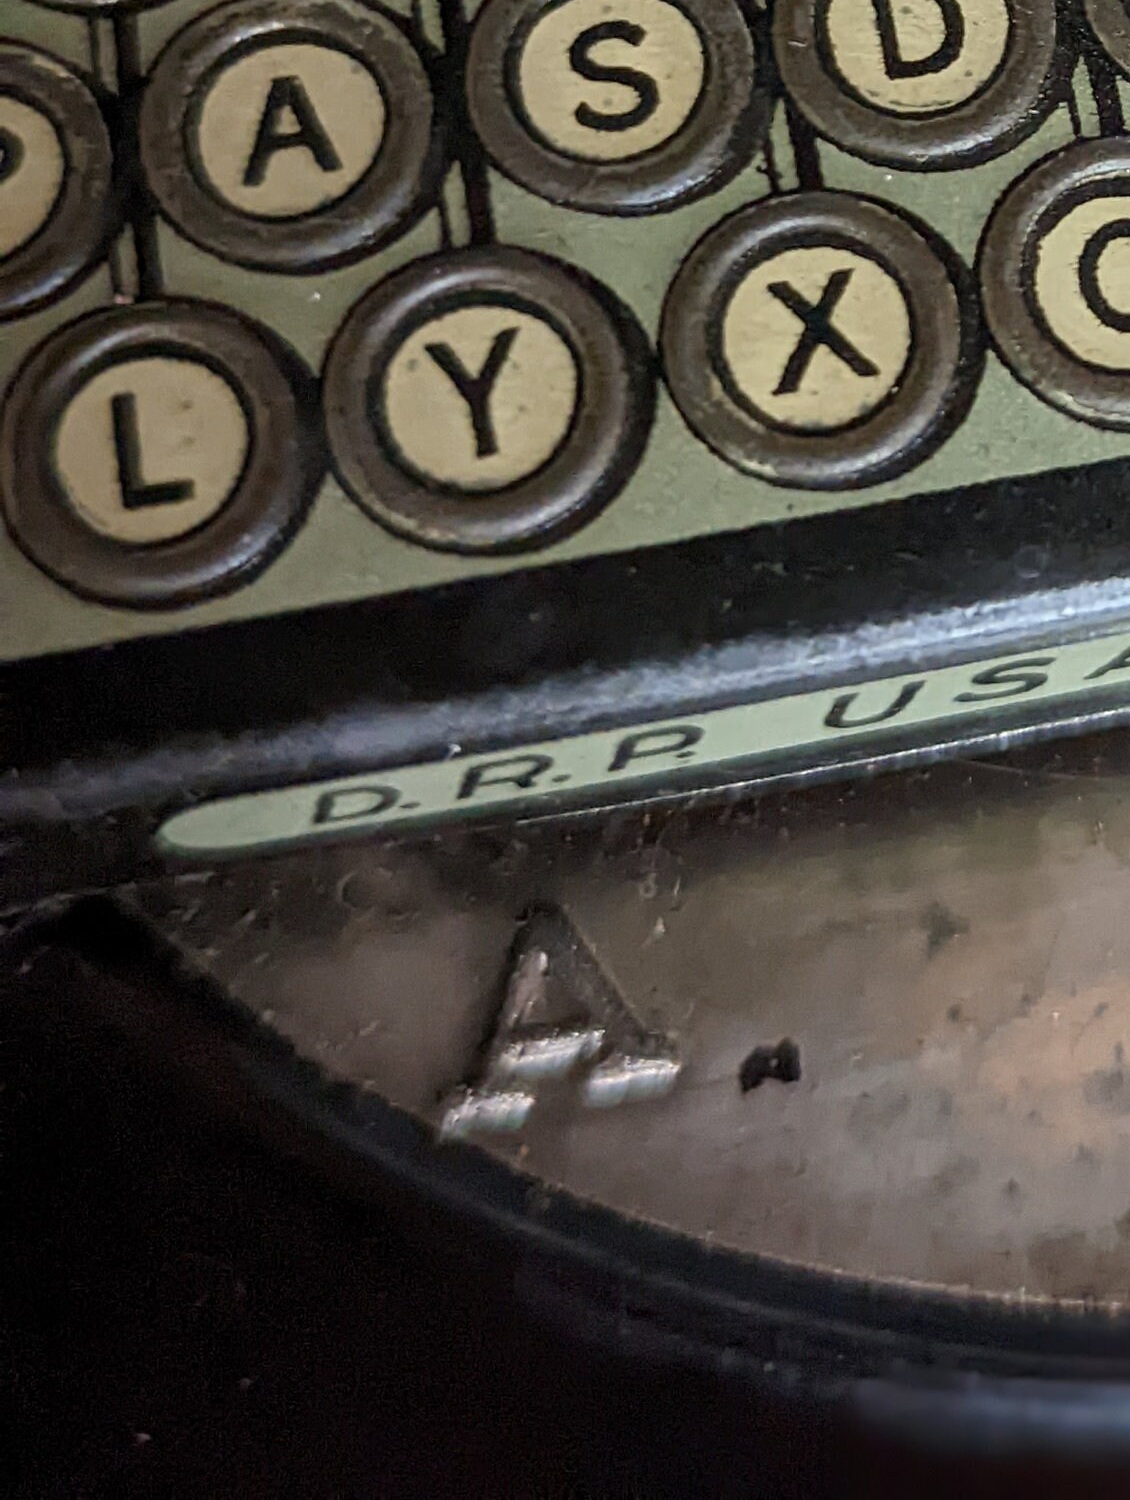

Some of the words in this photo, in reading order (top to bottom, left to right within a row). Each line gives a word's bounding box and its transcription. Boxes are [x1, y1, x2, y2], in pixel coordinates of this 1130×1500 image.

[242, 76, 341, 186] A
[567, 20, 659, 132] S
[110, 393, 193, 511] L
[424, 328, 518, 459] Y
[767, 269, 879, 396] X
